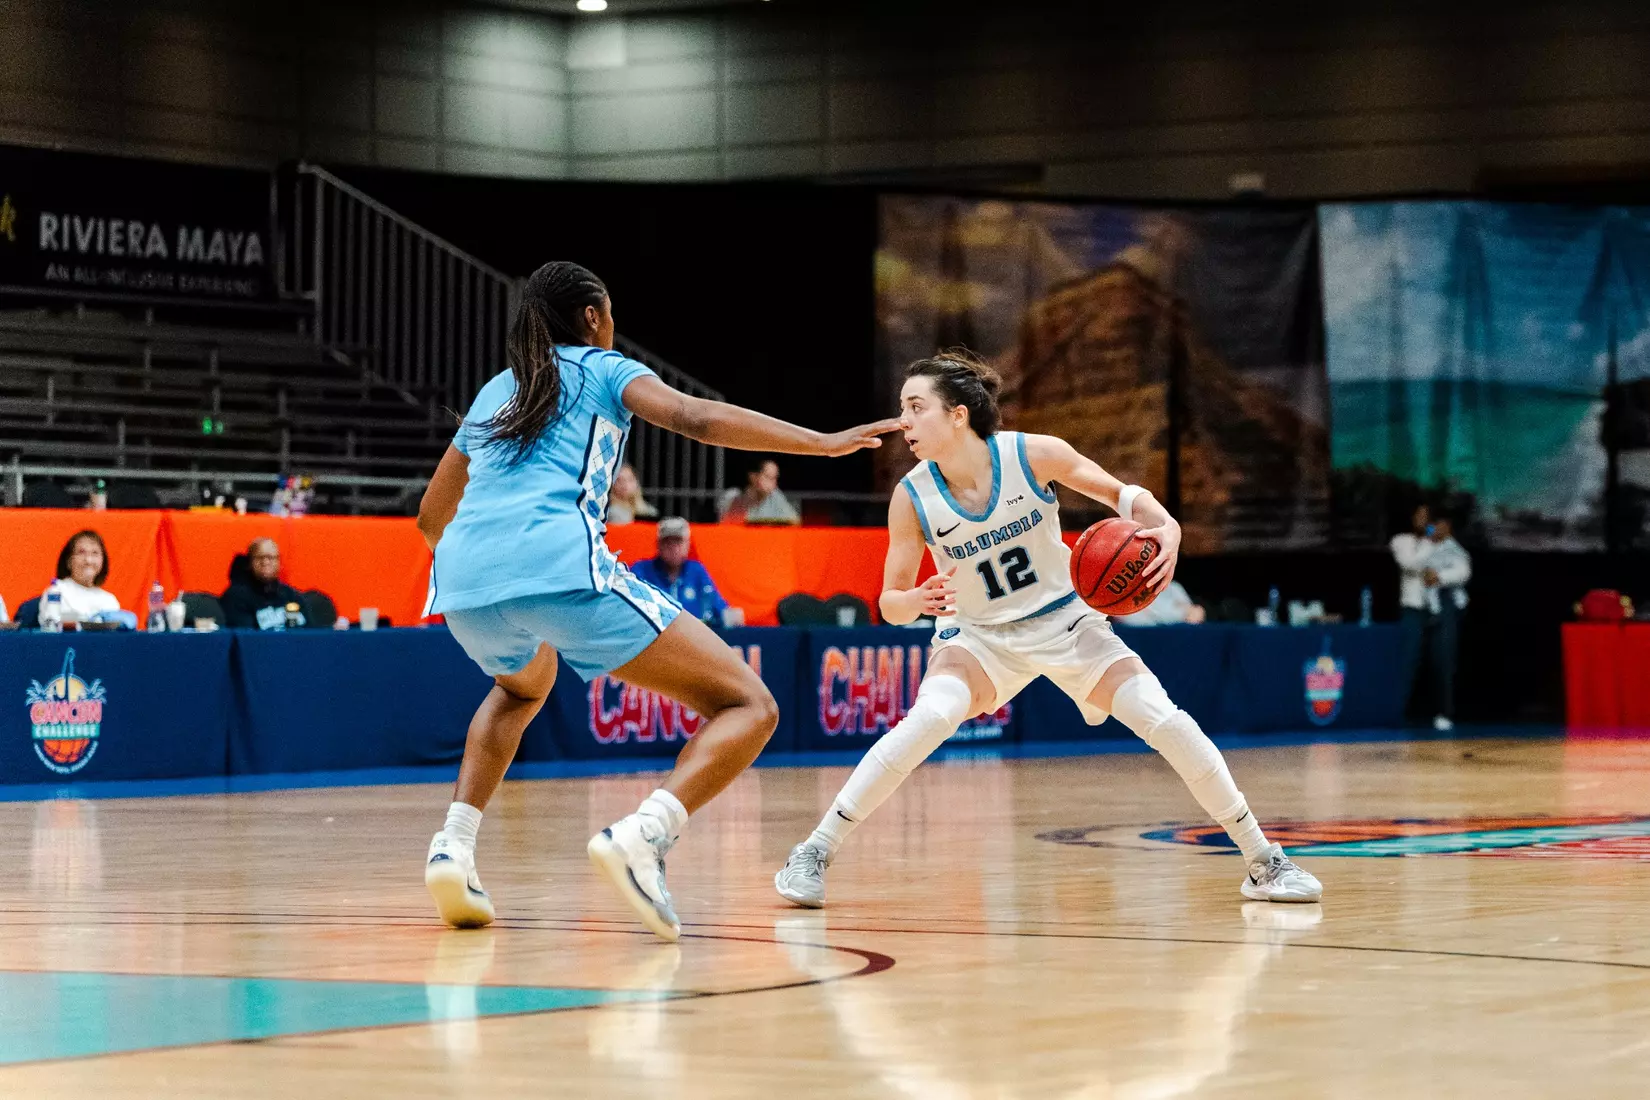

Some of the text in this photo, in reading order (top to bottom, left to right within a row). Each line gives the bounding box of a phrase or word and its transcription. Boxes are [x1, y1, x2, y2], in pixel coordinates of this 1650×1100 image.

[39, 211, 264, 266] RIVIERA MAYA
[1006, 496, 1019, 506] Ivy
[975, 545, 1040, 602] 12
[1105, 540, 1155, 595] Wilson
